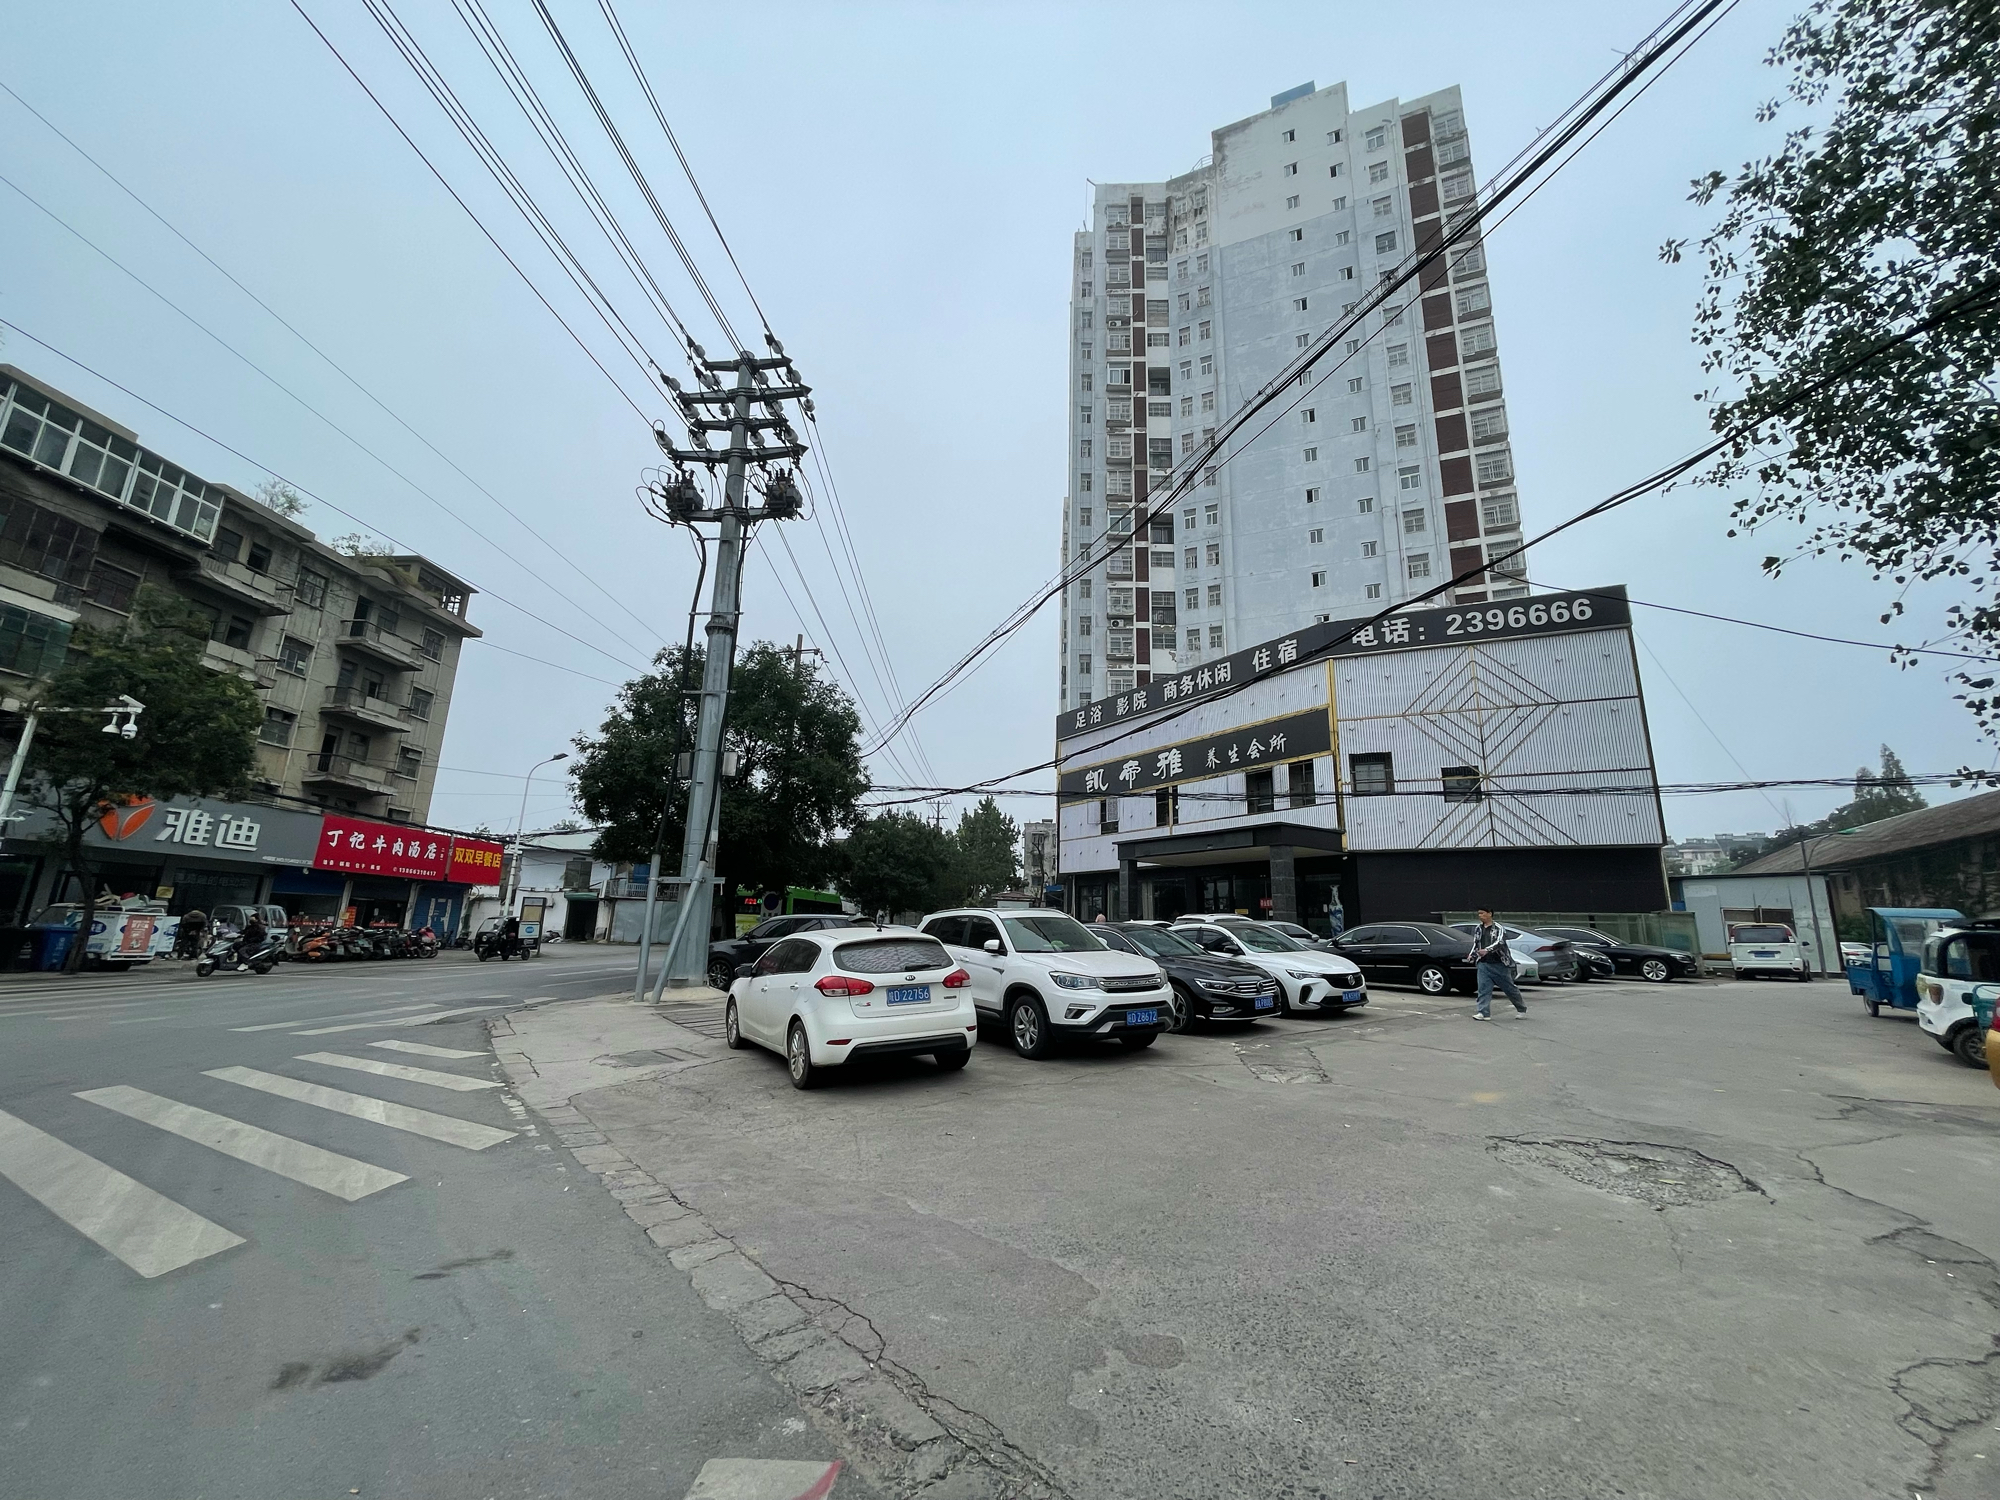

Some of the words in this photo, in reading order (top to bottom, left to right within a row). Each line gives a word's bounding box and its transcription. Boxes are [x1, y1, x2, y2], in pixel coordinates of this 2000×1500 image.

[1075, 704, 1103, 729] 足浴
[1116, 690, 1147, 716] 影院
[1162, 661, 1231, 701] 商务休闲
[1252, 637, 1298, 673] 住宿
[1085, 748, 1184, 793] 凯帝雅
[1205, 732, 1287, 769] 养生会所
[155, 807, 261, 851] 雅迪
[327, 829, 438, 860] 丁记牛肉汤店
[454, 847, 502, 868] 双双早餐店
